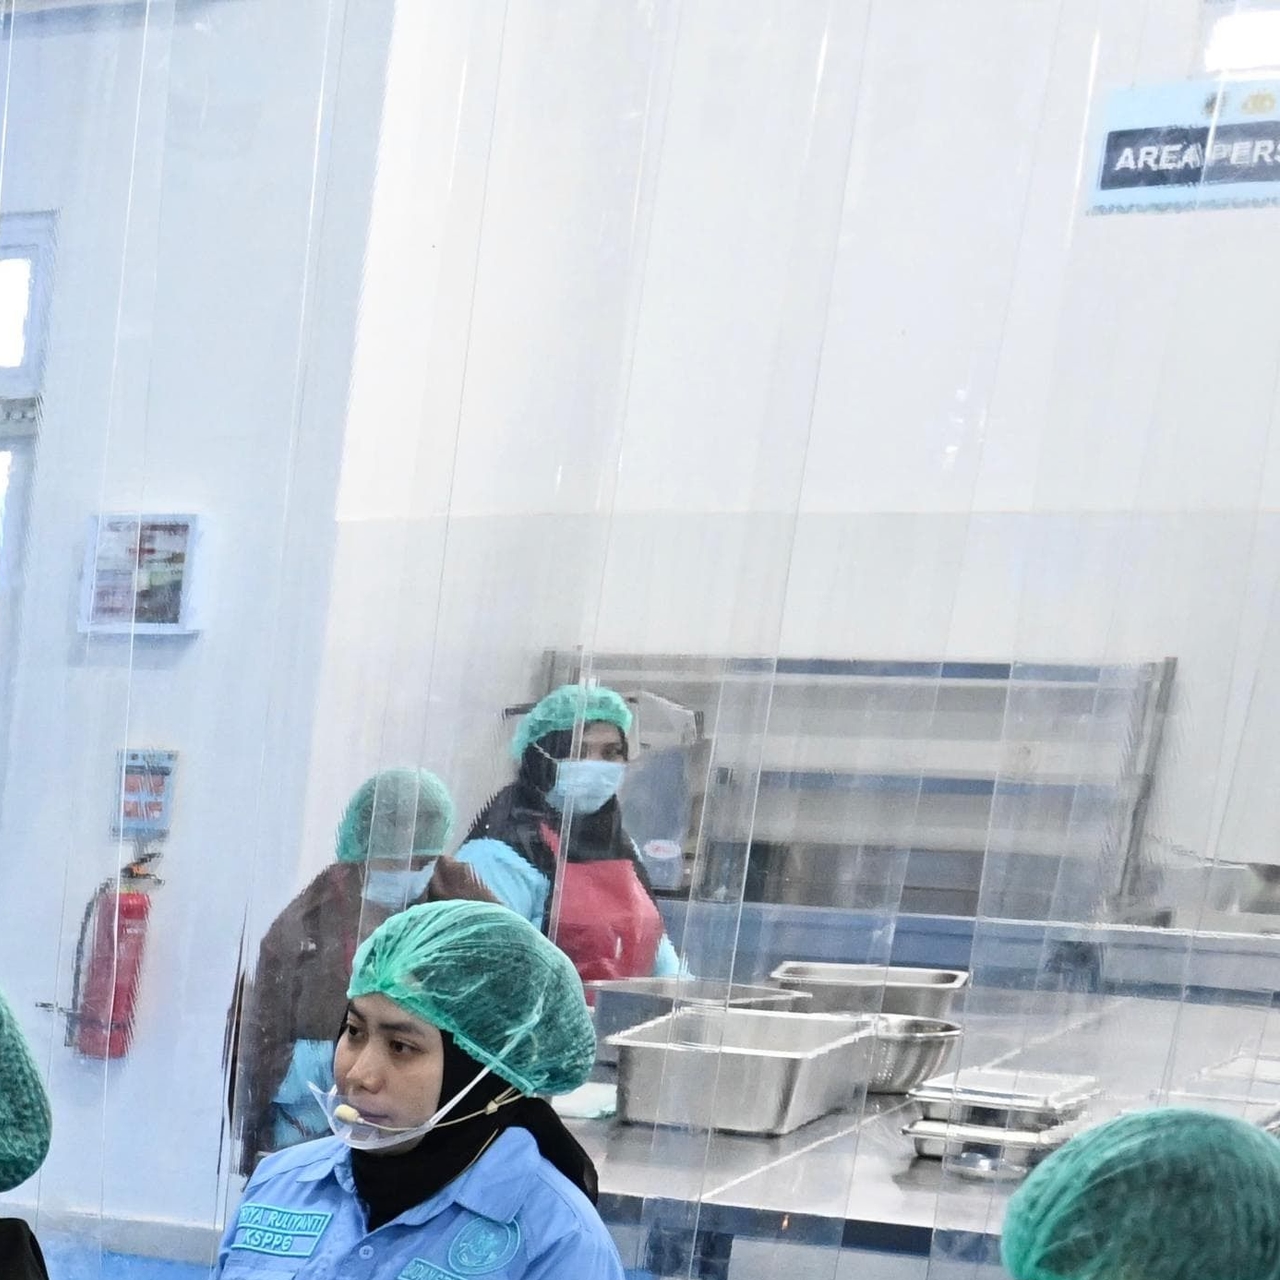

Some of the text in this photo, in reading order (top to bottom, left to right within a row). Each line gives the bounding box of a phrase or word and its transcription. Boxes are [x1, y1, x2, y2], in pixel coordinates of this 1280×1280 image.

[1114, 139, 1280, 170] AREA PER
[244, 1228, 293, 1251] KSPPG
